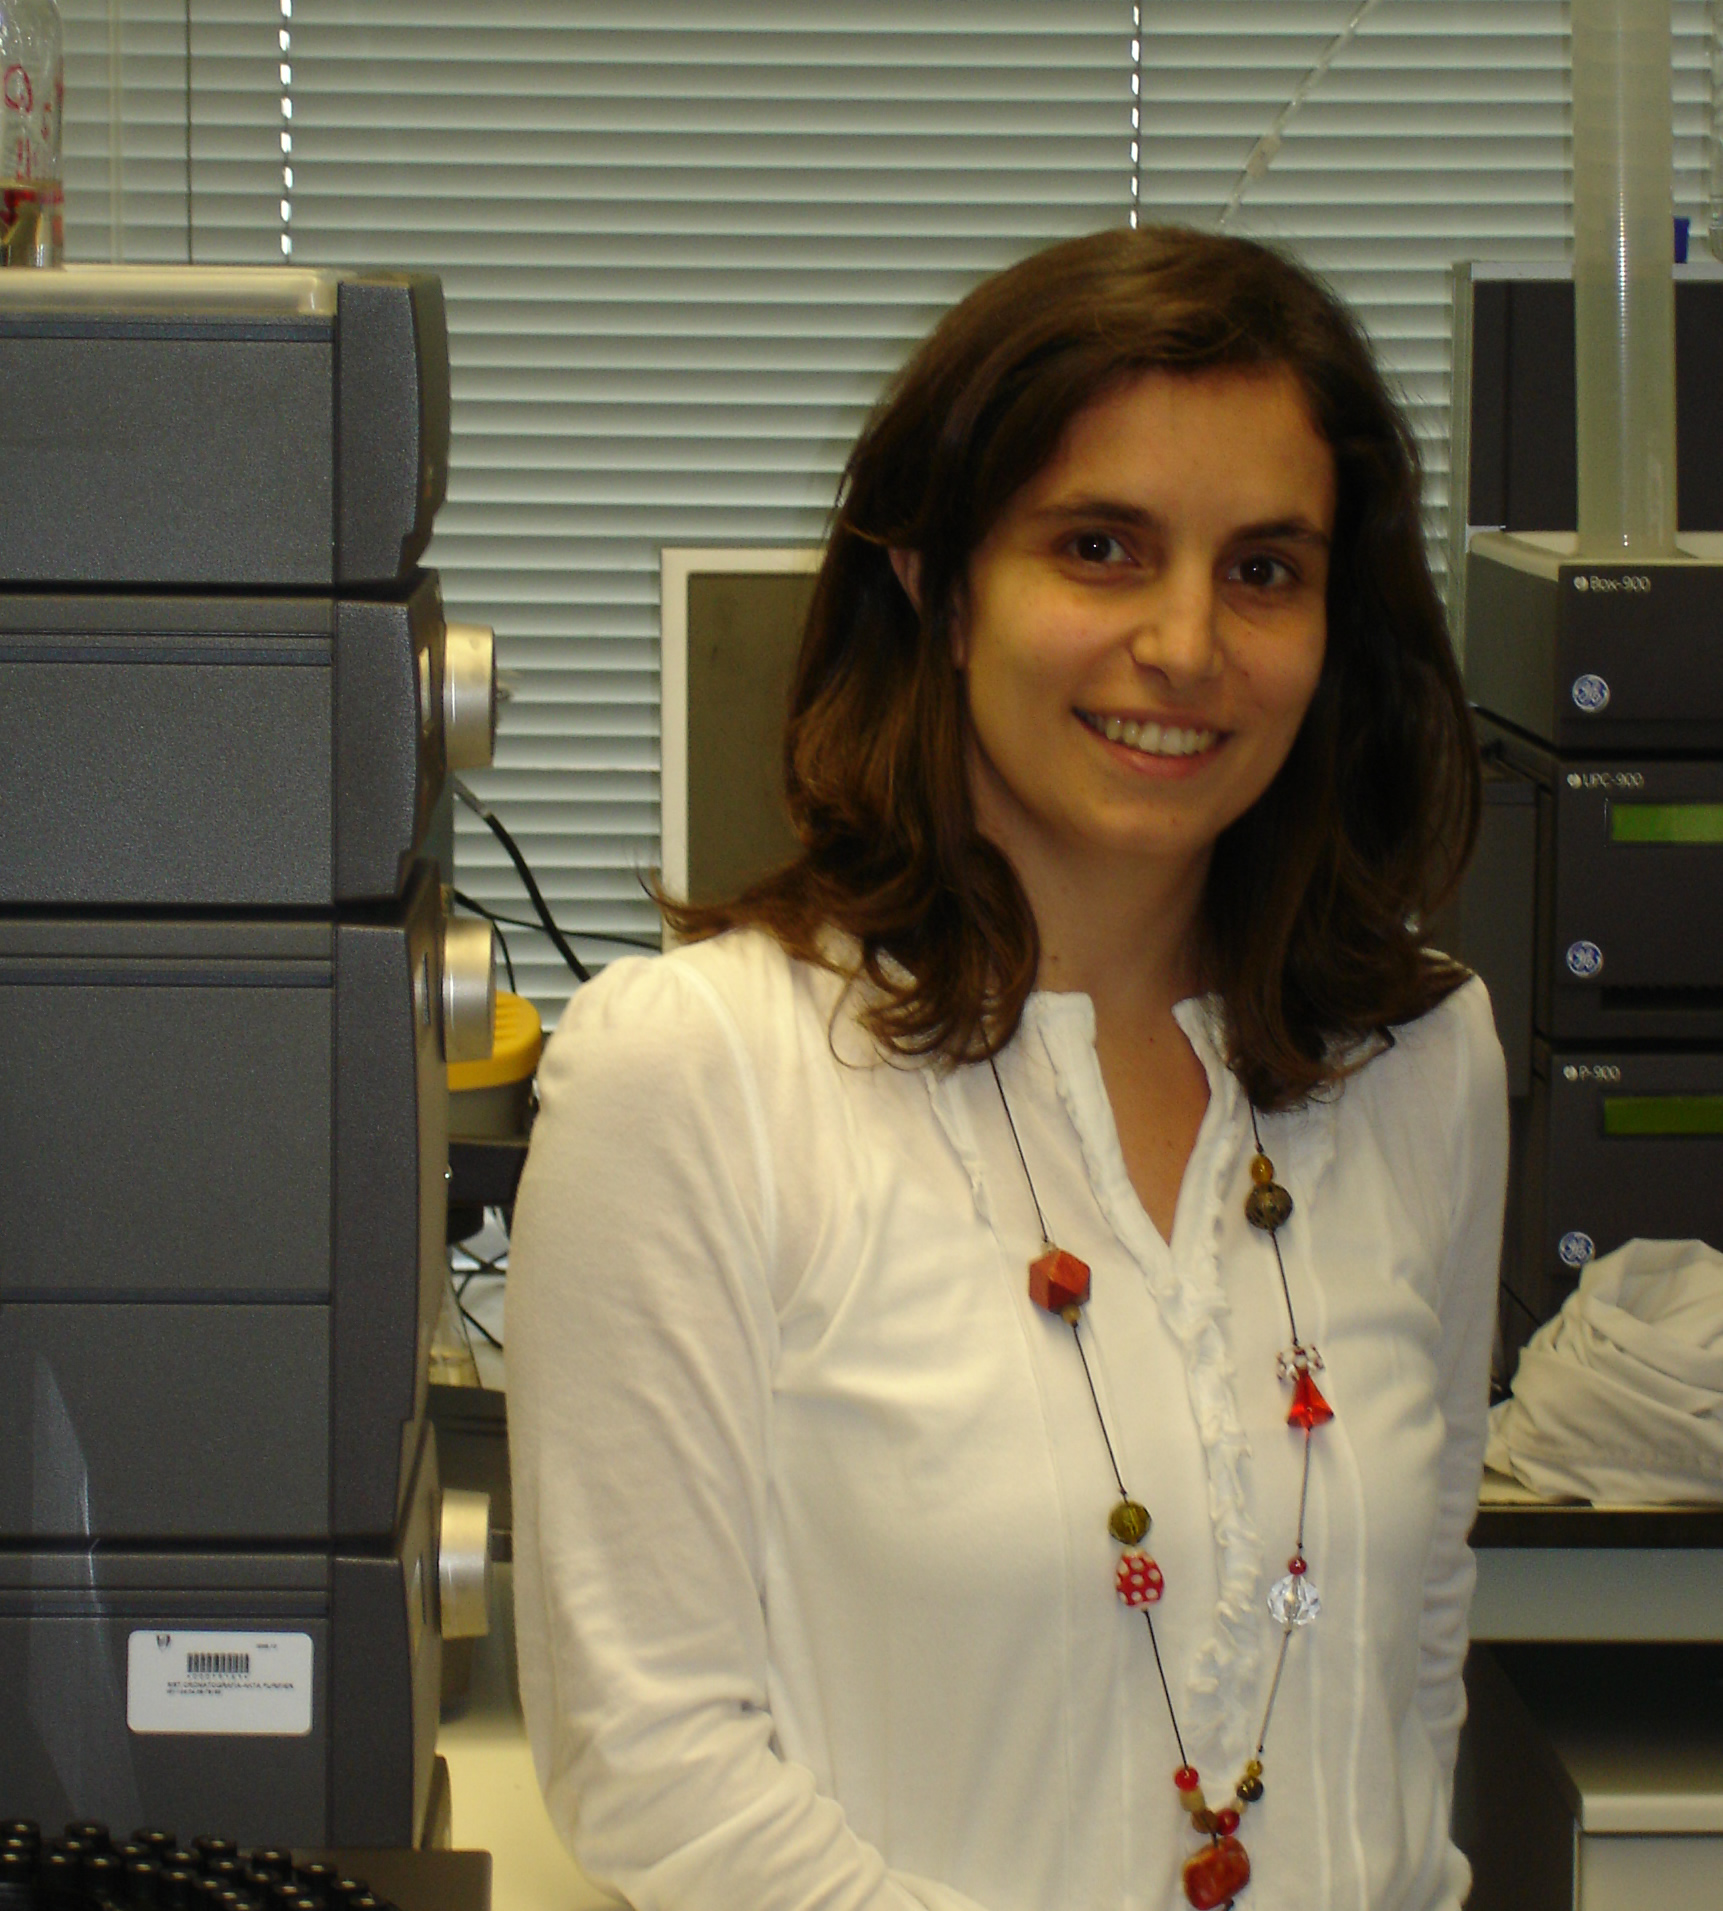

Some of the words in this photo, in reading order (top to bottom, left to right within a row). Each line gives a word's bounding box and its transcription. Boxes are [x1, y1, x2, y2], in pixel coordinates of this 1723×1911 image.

[1589, 575, 1652, 592] Box-900
[1582, 772, 1645, 788] UPC-900
[1578, 1065, 1622, 1081] P-900
